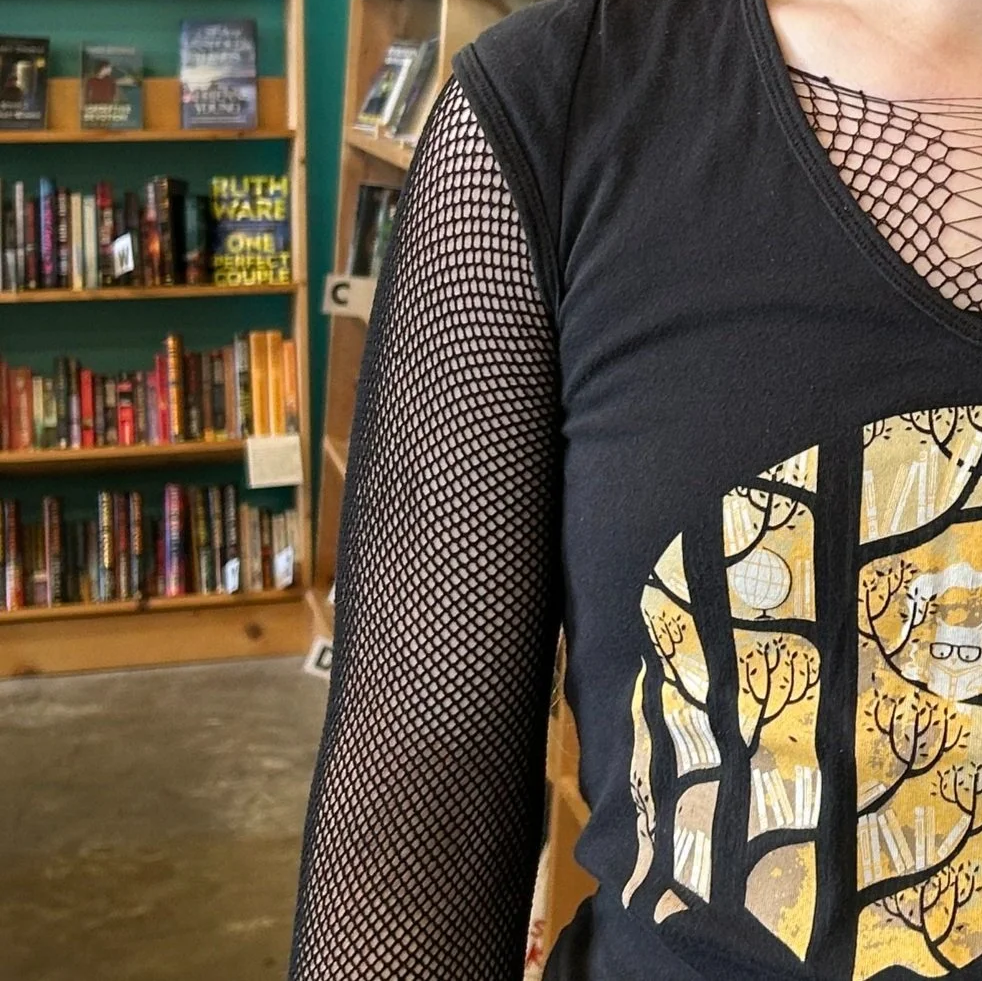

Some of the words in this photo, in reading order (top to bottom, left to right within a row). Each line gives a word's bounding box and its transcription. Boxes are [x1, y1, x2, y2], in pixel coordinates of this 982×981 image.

[212, 176, 289, 198] RUTH
[212, 199, 286, 221] WARE
[227, 231, 276, 254] ONE
[213, 270, 290, 287] COUPLE
[332, 282, 351, 307] C
